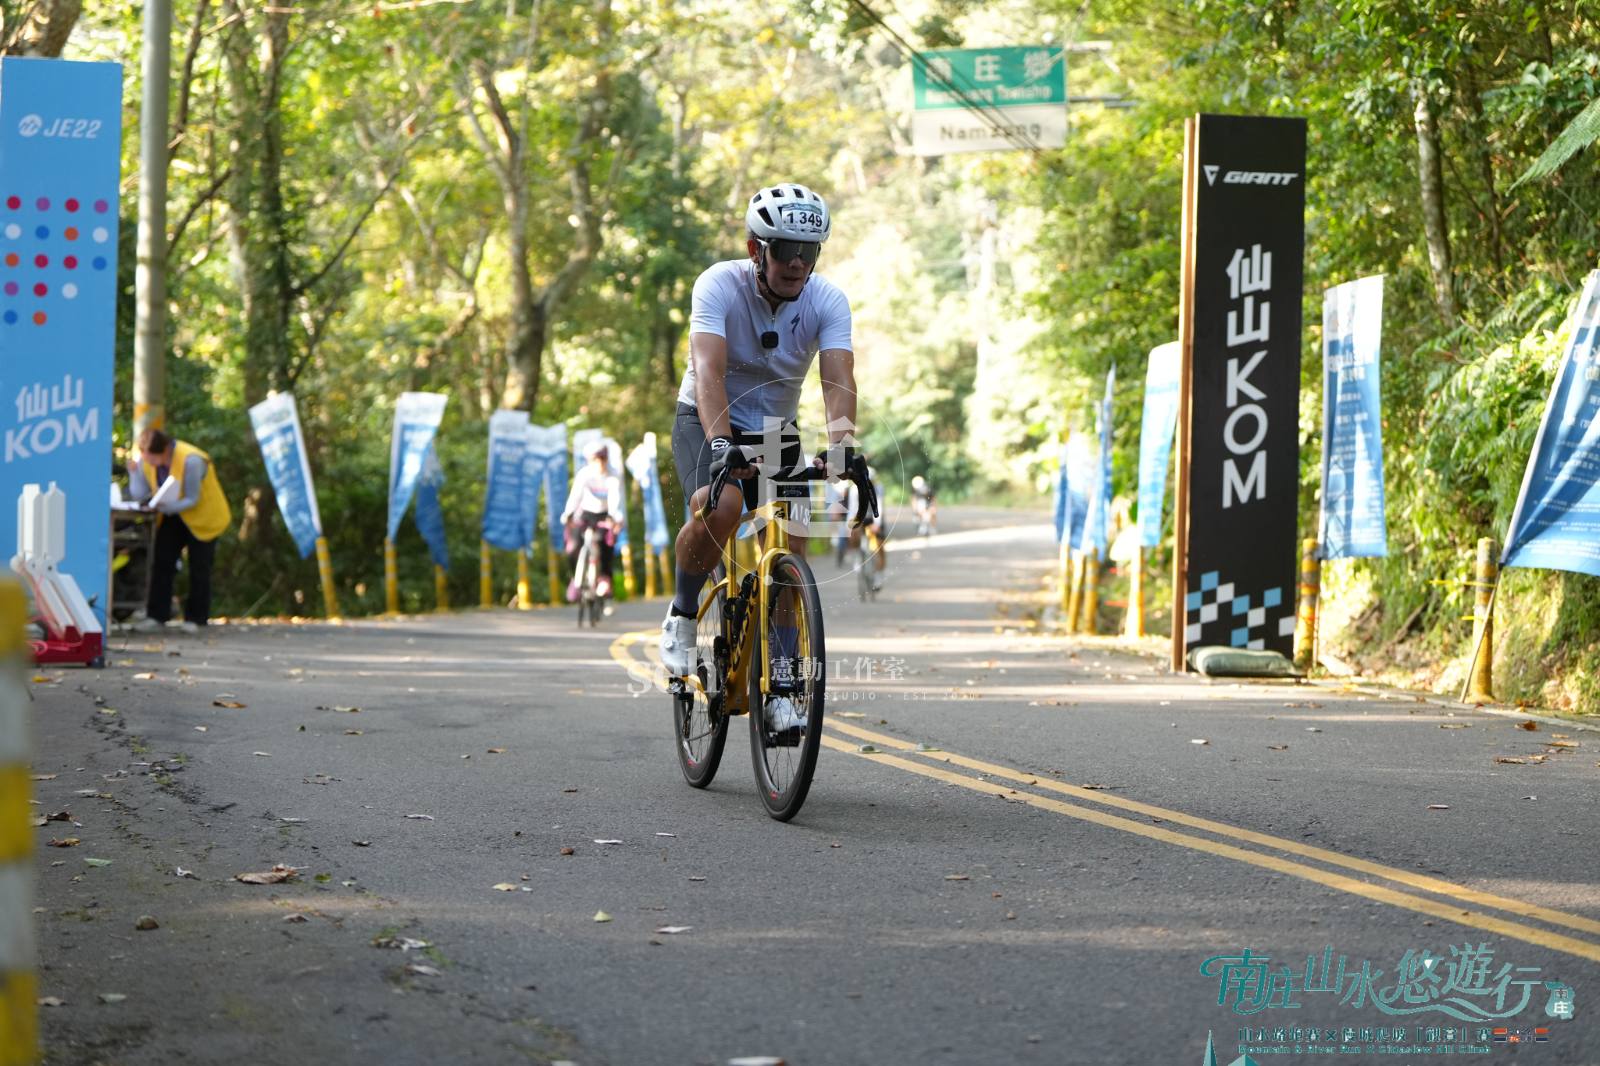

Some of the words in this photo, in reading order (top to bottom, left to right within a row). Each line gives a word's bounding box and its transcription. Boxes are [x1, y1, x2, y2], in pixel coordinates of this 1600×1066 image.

[43, 118, 102, 139] JE22
[1223, 170, 1299, 186] GIANT
[1225, 243, 1273, 347] 仙山
[15, 373, 84, 424] 仙山
[4, 406, 99, 464] KOM
[1221, 350, 1269, 510] KOM
